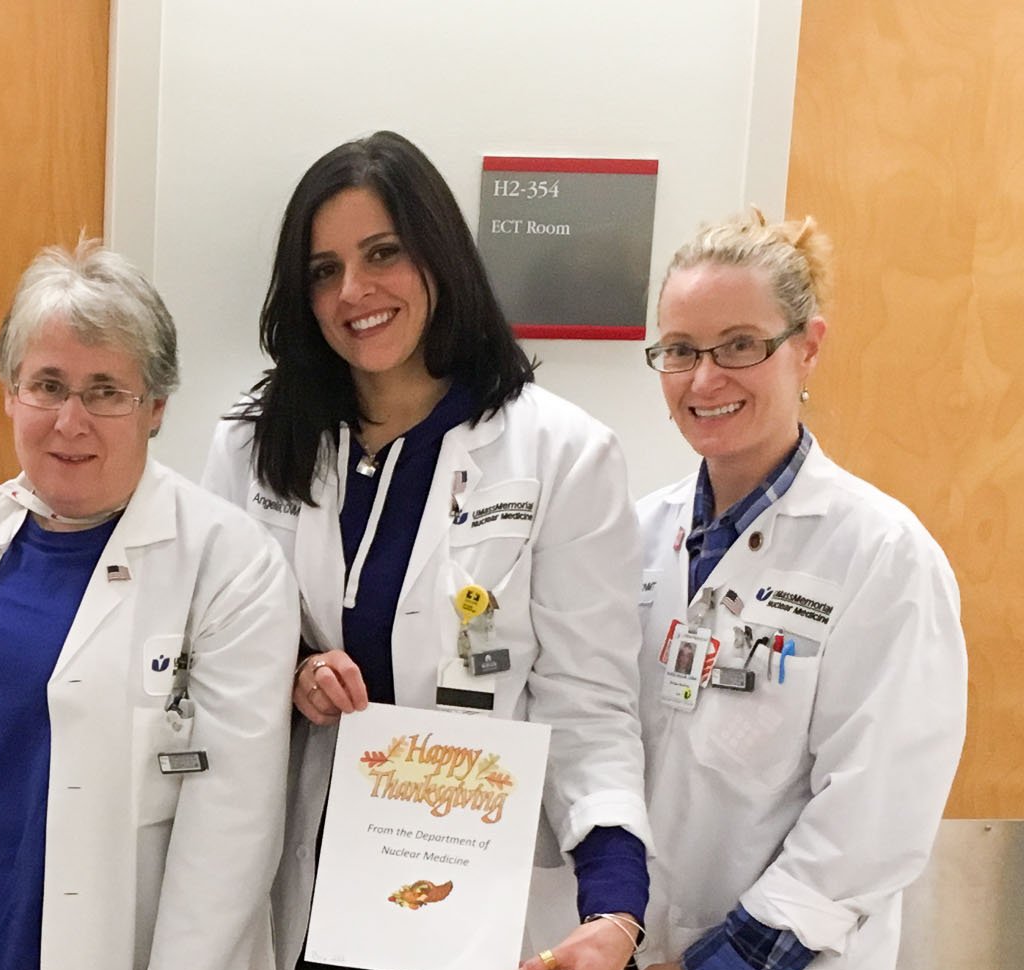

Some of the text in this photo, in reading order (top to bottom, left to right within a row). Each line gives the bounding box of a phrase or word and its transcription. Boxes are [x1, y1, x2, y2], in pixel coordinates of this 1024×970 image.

[493, 179, 560, 199] H2-354
[491, 219, 570, 235] ECT Room
[471, 512, 533, 528] Nuclear Medicine
[405, 732, 482, 781] Happy
[368, 768, 509, 824] Thanksgiving
[367, 823, 491, 851] From the Department of
[381, 845, 470, 866] Nuclear Medicine
